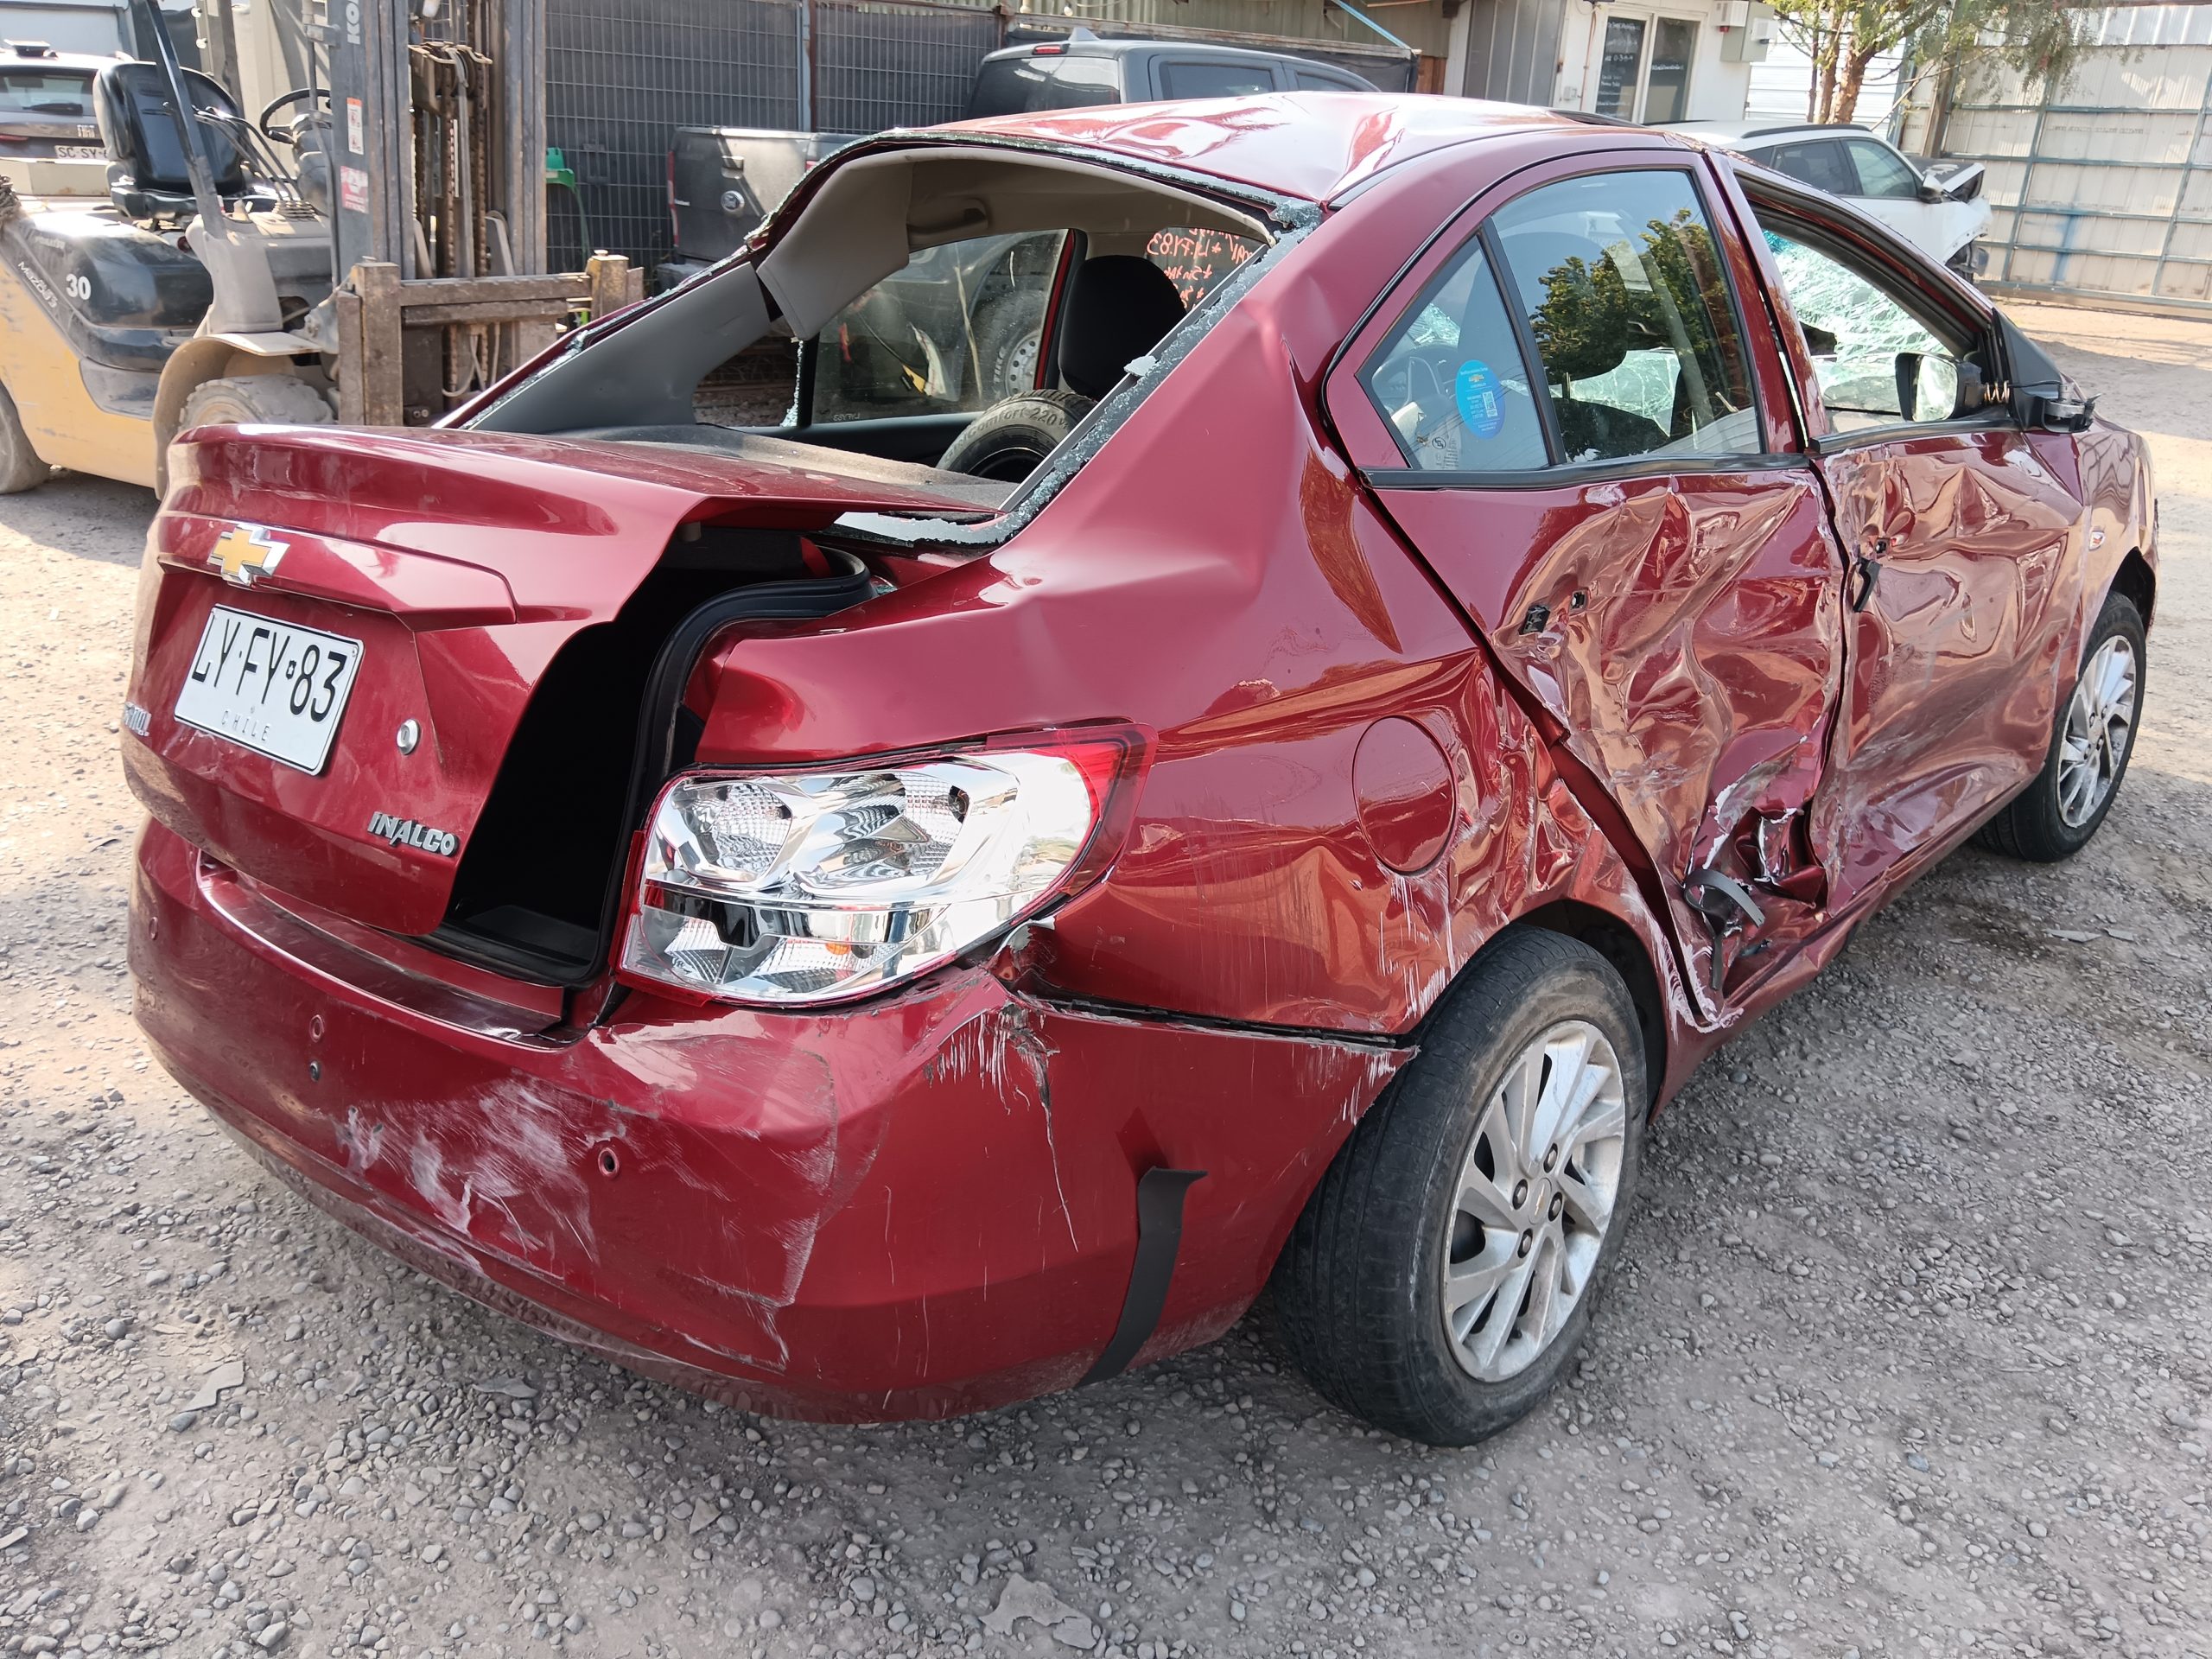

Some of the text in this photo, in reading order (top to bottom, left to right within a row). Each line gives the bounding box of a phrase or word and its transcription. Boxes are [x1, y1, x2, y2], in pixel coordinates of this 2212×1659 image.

[346, 0, 361, 44] KO
[66, 273, 92, 301] 30
[1029, 405, 1058, 426] 220
[220, 709, 270, 741] CHILE
[367, 810, 458, 856] INALCO
